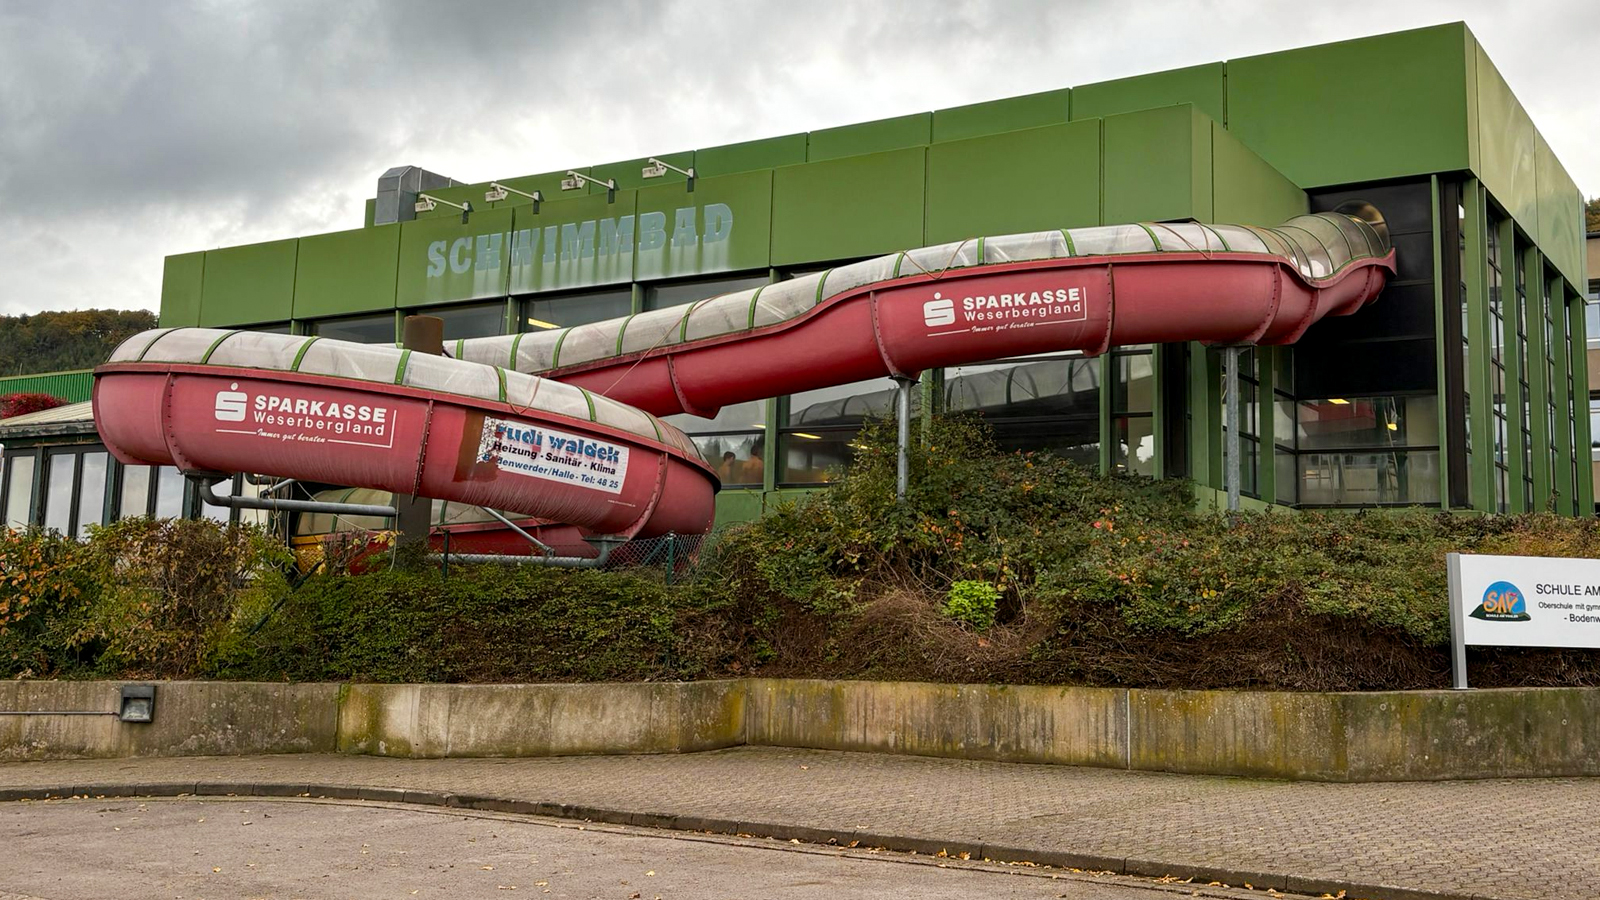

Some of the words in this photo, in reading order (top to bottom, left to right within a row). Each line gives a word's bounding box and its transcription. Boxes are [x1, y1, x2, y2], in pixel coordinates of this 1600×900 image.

[427, 203, 733, 278] SCHWIMMBAD
[963, 288, 1080, 311] SPARKASSE
[963, 302, 1081, 322] Weserbergland
[971, 325, 994, 334] Immer
[995, 323, 1009, 333] gut
[1009, 321, 1035, 330] beraten
[254, 395, 387, 423] SPARKASSE
[254, 411, 385, 437] Weserbergland
[257, 428, 281, 439] Immer
[282, 433, 297, 442] gut
[297, 433, 326, 443] beraten
[493, 441, 538, 460] Heizung
[545, 452, 582, 468] Sanitär
[590, 461, 616, 475] Klima
[581, 473, 596, 484] Tel:
[597, 477, 608, 487] 48
[608, 480, 619, 489] 25
[1536, 583, 1582, 596] SCHULE
[1584, 585, 1600, 596] AM
[1538, 601, 1573, 610] Oberschule
[1575, 602, 1585, 610] mit
